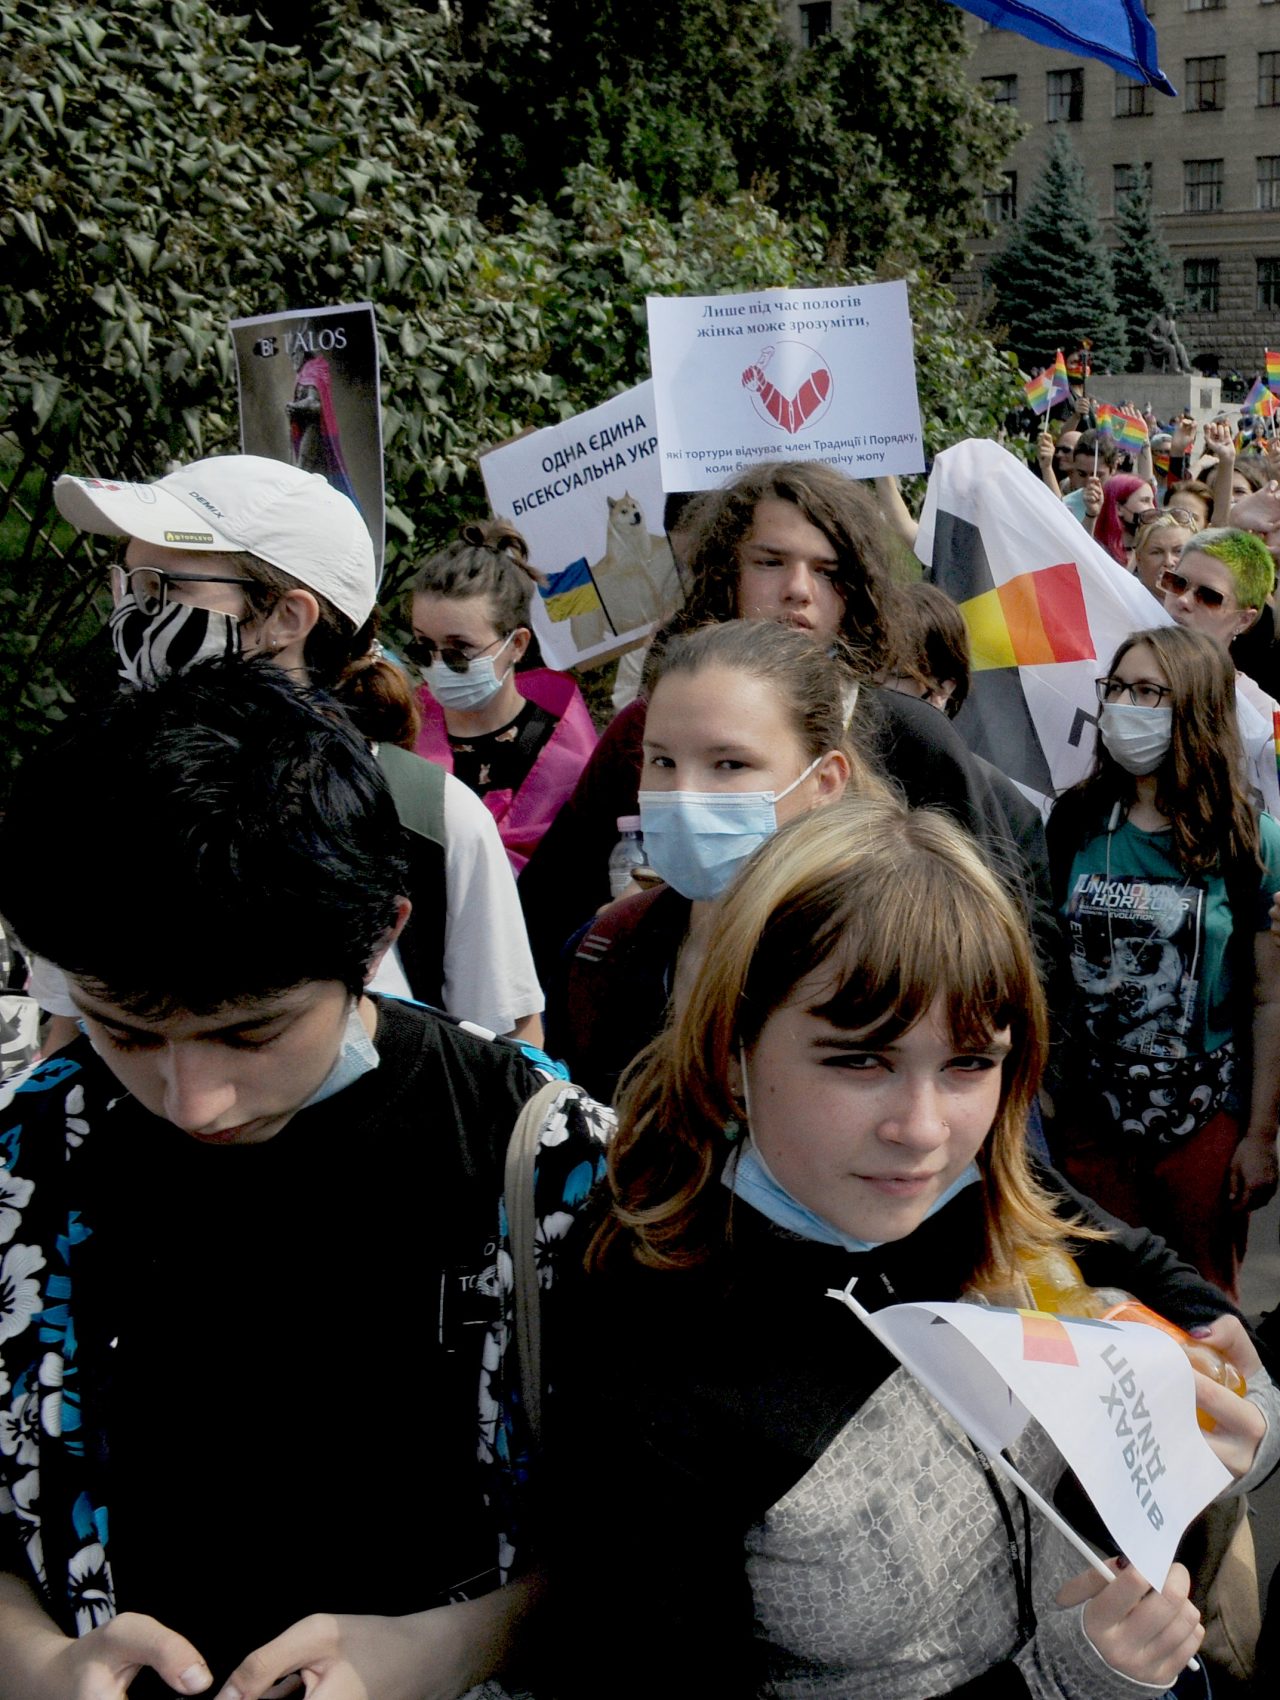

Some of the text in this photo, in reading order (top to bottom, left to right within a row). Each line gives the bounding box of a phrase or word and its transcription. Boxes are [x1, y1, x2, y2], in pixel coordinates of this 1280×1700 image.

[701, 295, 862, 319] Лише під час пологів
[697, 314, 870, 338] жінка може зрозуміти,
[541, 414, 647, 473] ОДНА ЄДИНА
[666, 449, 683, 460] які
[685, 447, 733, 462] тортури
[735, 443, 783, 459] відчуває
[784, 441, 811, 453] член
[814, 437, 861, 452] Традиції
[869, 432, 919, 449] Порядку,
[705, 463, 734, 474] коли
[856, 450, 886, 464] жопу
[512, 451, 627, 517] БІСЕКСУАЛЬНА
[188, 491, 225, 520] DEMIX
